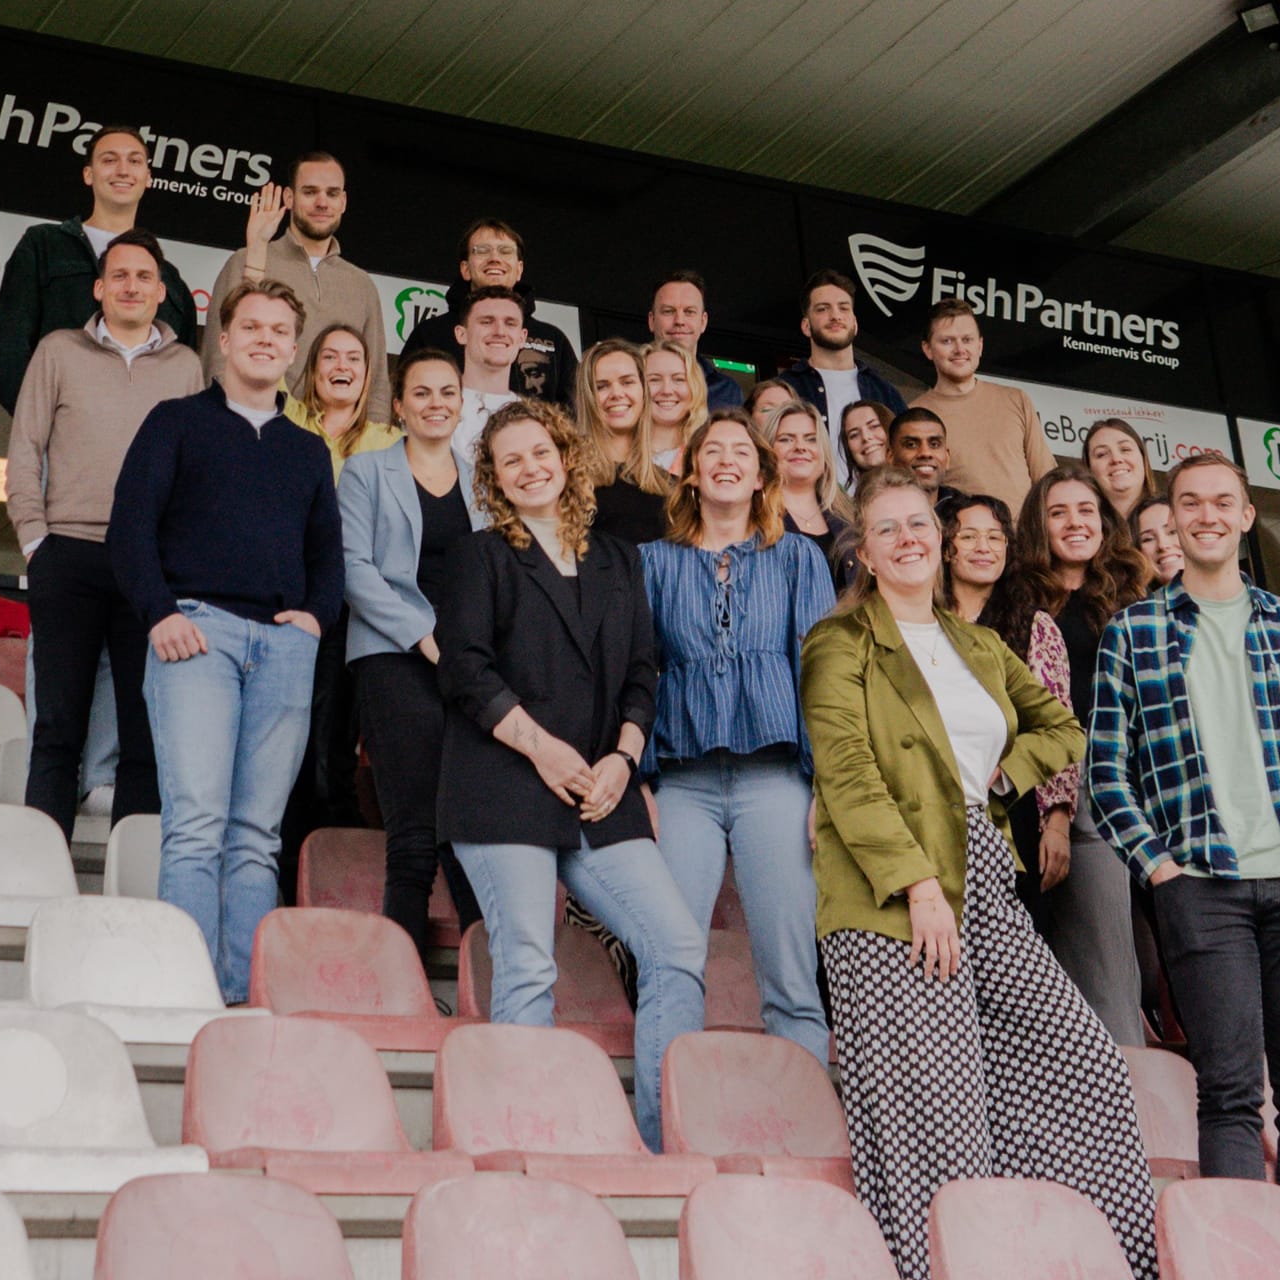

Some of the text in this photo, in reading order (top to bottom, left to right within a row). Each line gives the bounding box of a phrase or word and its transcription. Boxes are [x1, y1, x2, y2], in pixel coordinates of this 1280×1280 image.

[213, 185, 261, 207] Grou
[931, 267, 1180, 350] FishPartners
[1063, 336, 1180, 369] Kennemervis Group
